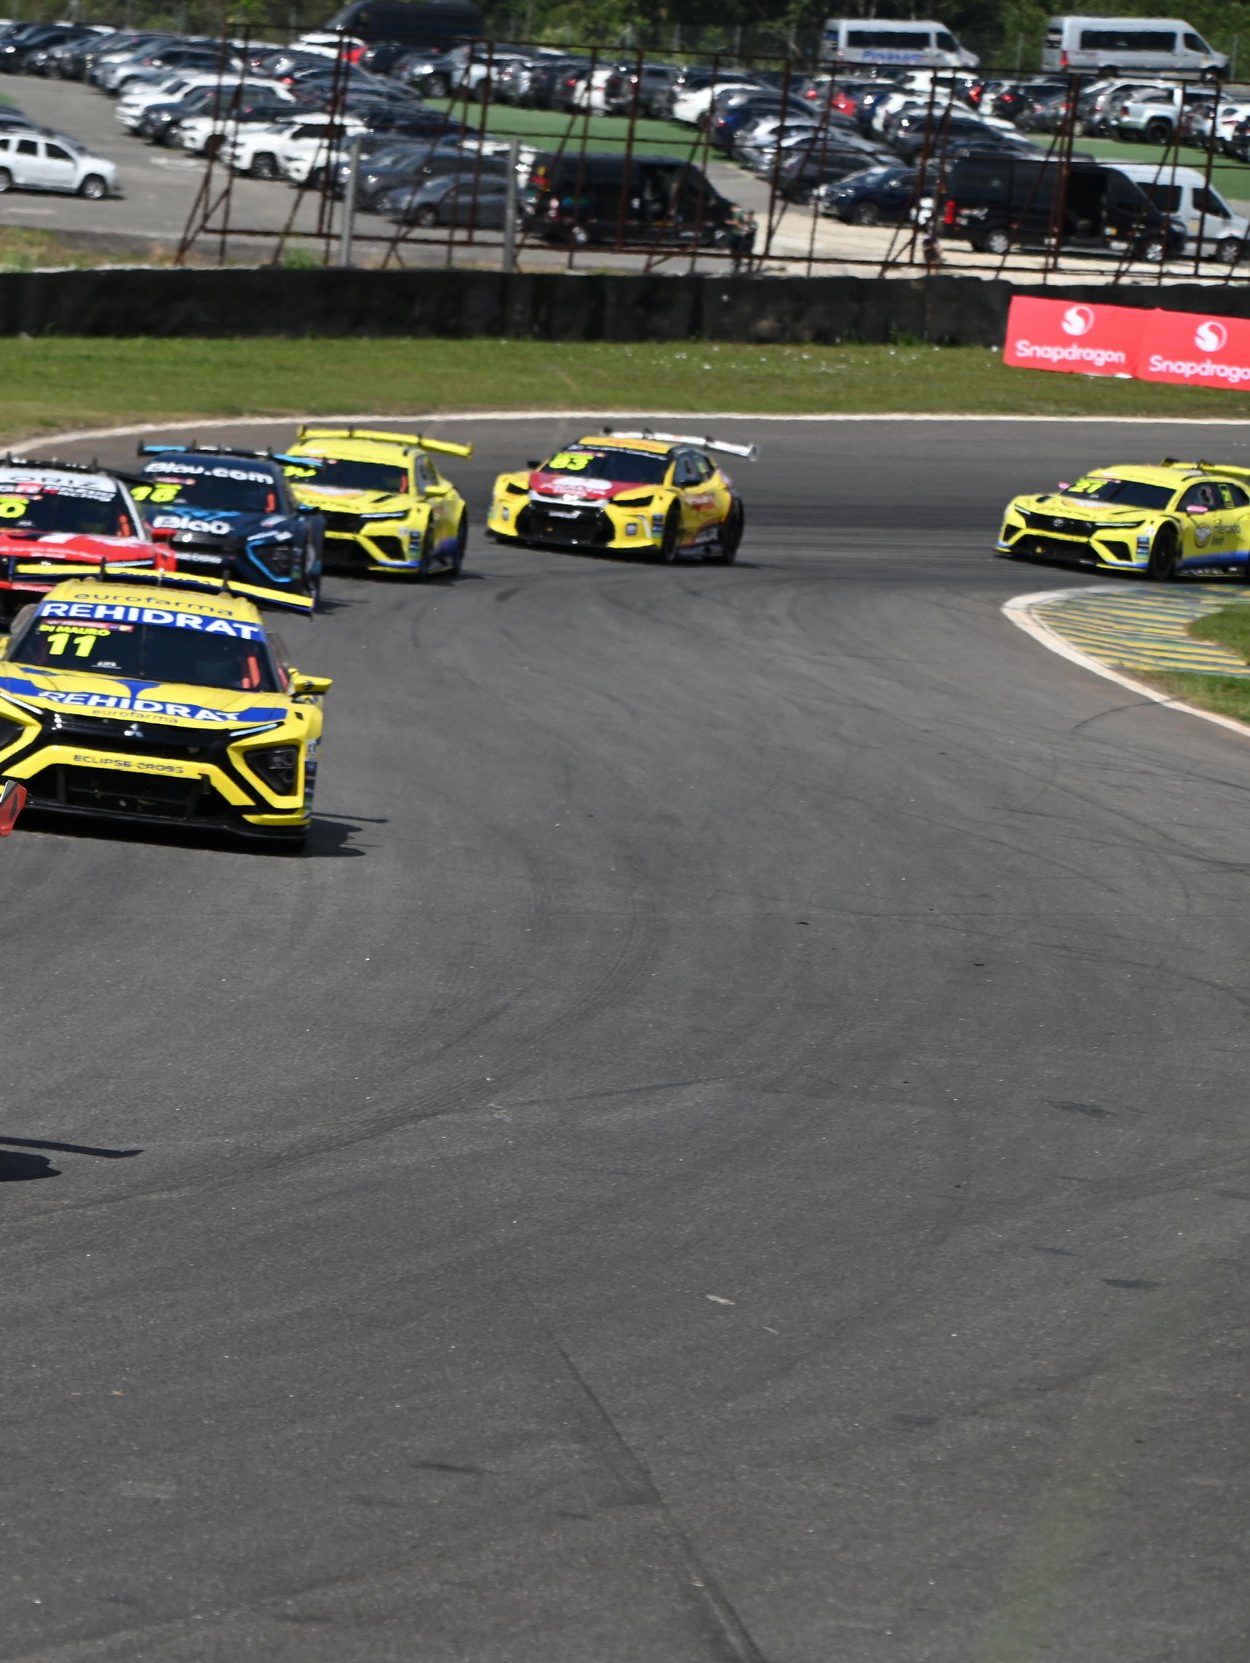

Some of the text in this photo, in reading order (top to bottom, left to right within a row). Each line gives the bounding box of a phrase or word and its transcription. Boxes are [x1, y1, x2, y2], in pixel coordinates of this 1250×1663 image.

[1015, 339, 1126, 367] Snapdragon
[74, 592, 233, 617] eurofarma
[40, 602, 260, 640] REHIDRAT
[55, 625, 111, 637] MAURO
[47, 633, 97, 657] 11
[38, 690, 240, 721] REHIDRAT
[91, 708, 179, 724] eurofarma
[73, 754, 184, 774] ECLIPSE CROSS
